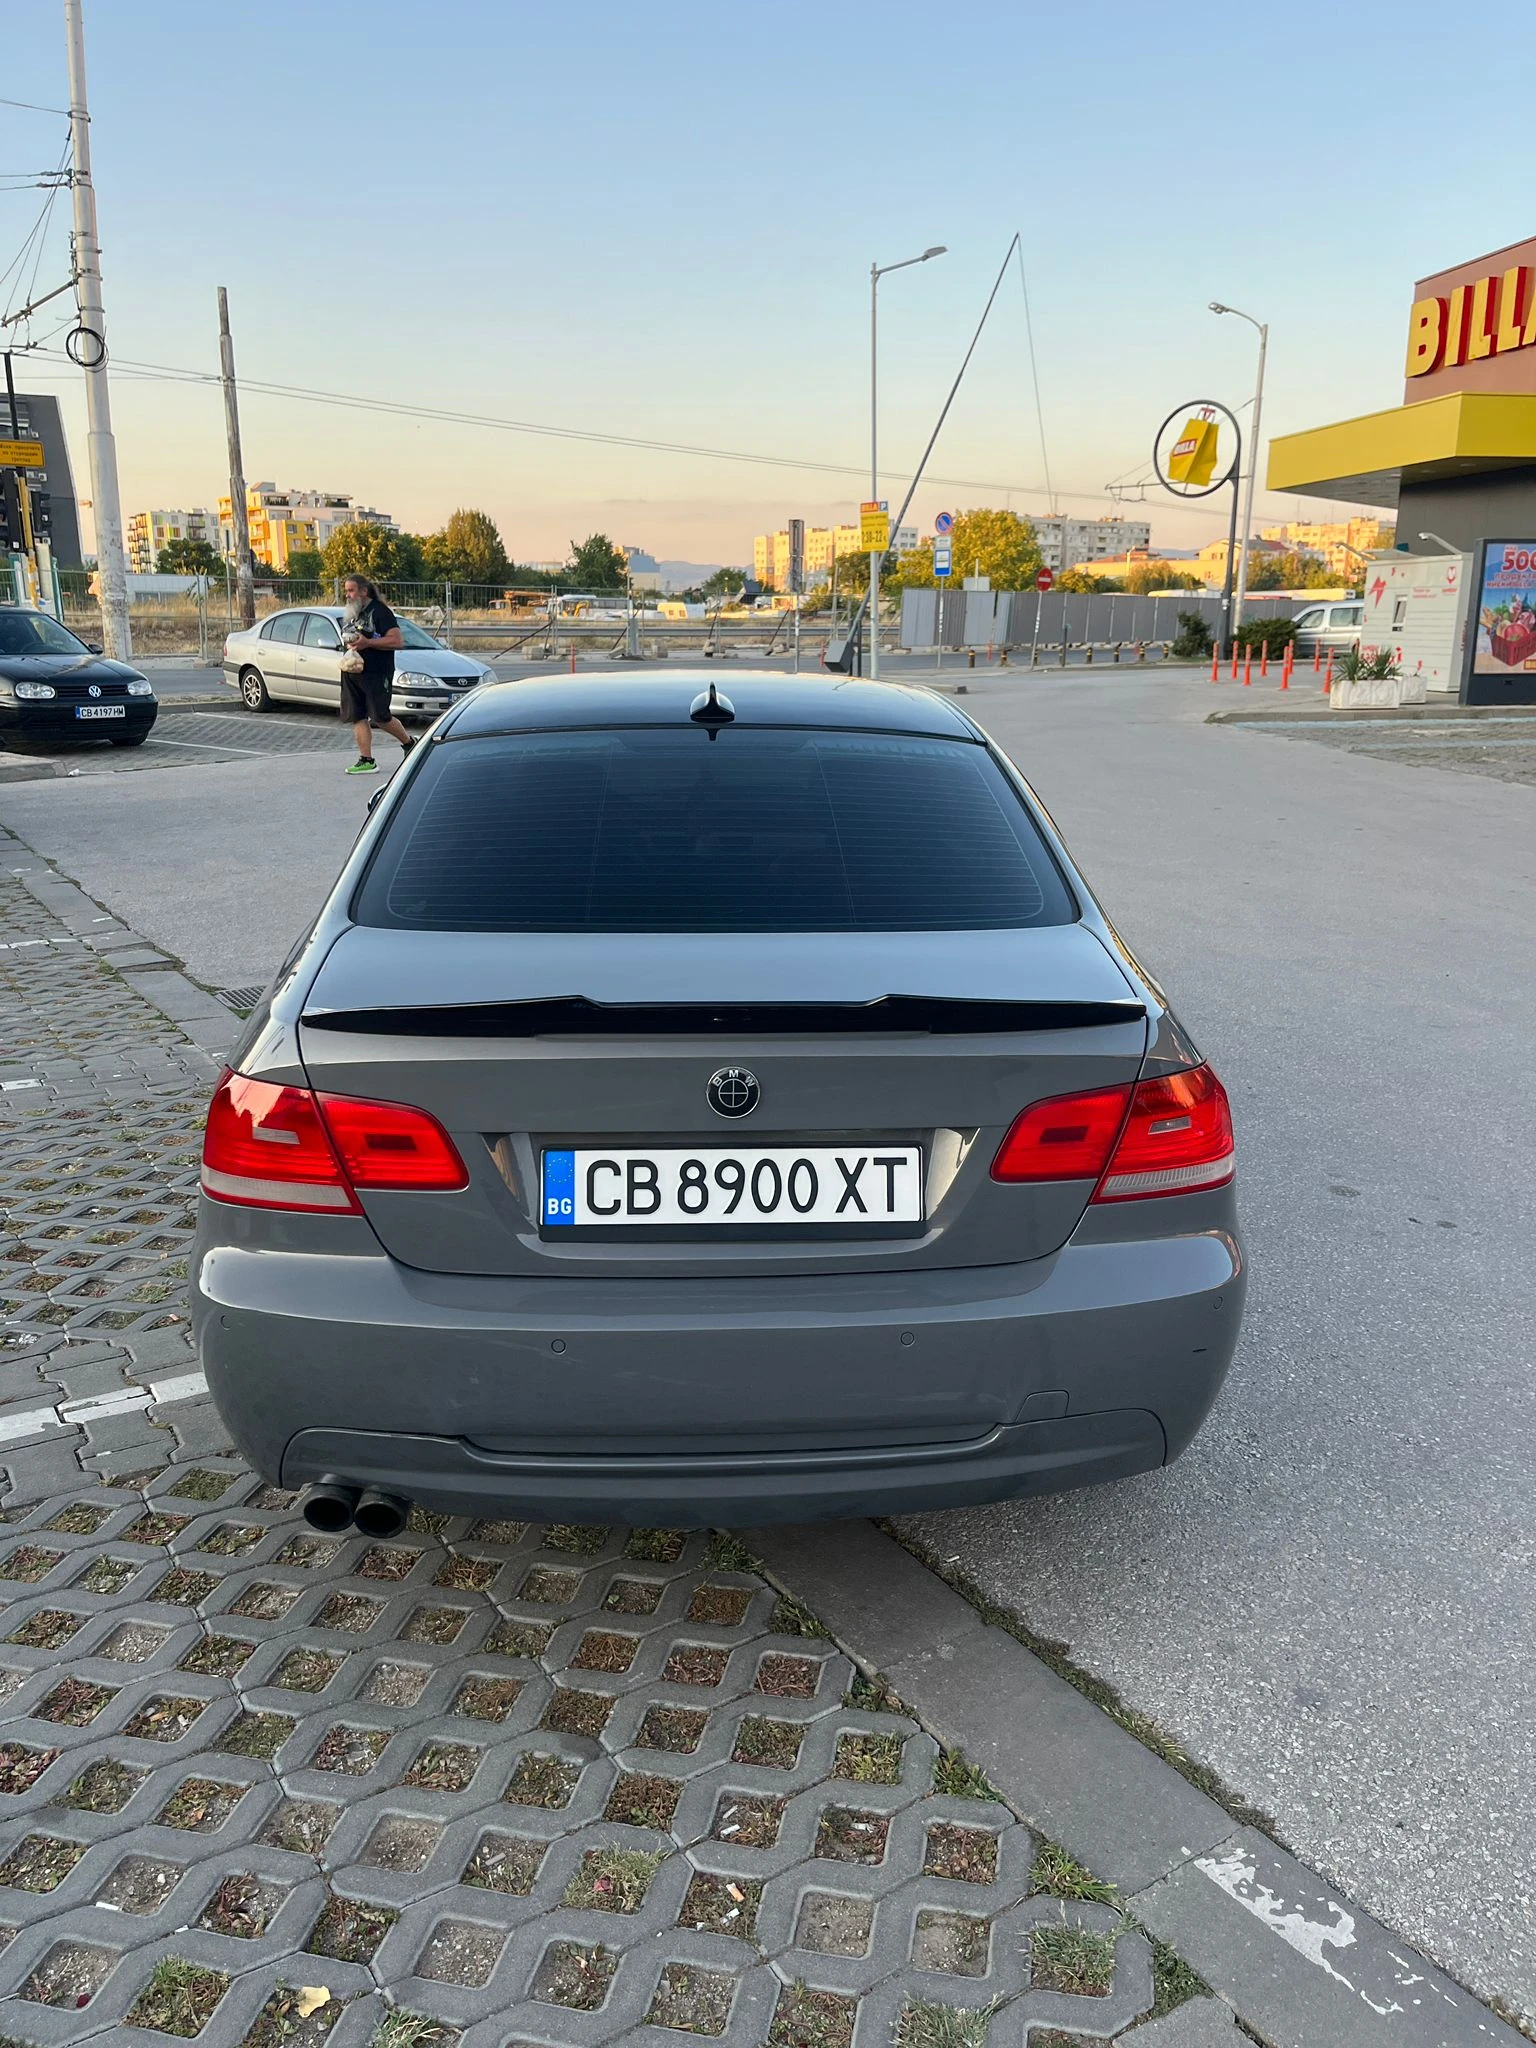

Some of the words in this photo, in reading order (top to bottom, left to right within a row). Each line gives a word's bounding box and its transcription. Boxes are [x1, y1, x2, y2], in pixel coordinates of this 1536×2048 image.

[81, 708, 92, 718] CB
[94, 708, 112, 717] 4197
[711, 1069, 756, 1087] BMW
[586, 1159, 661, 1216] CB
[677, 1158, 819, 1215] 8900
[835, 1157, 907, 1214] XT
[547, 1198, 572, 1215] BG
